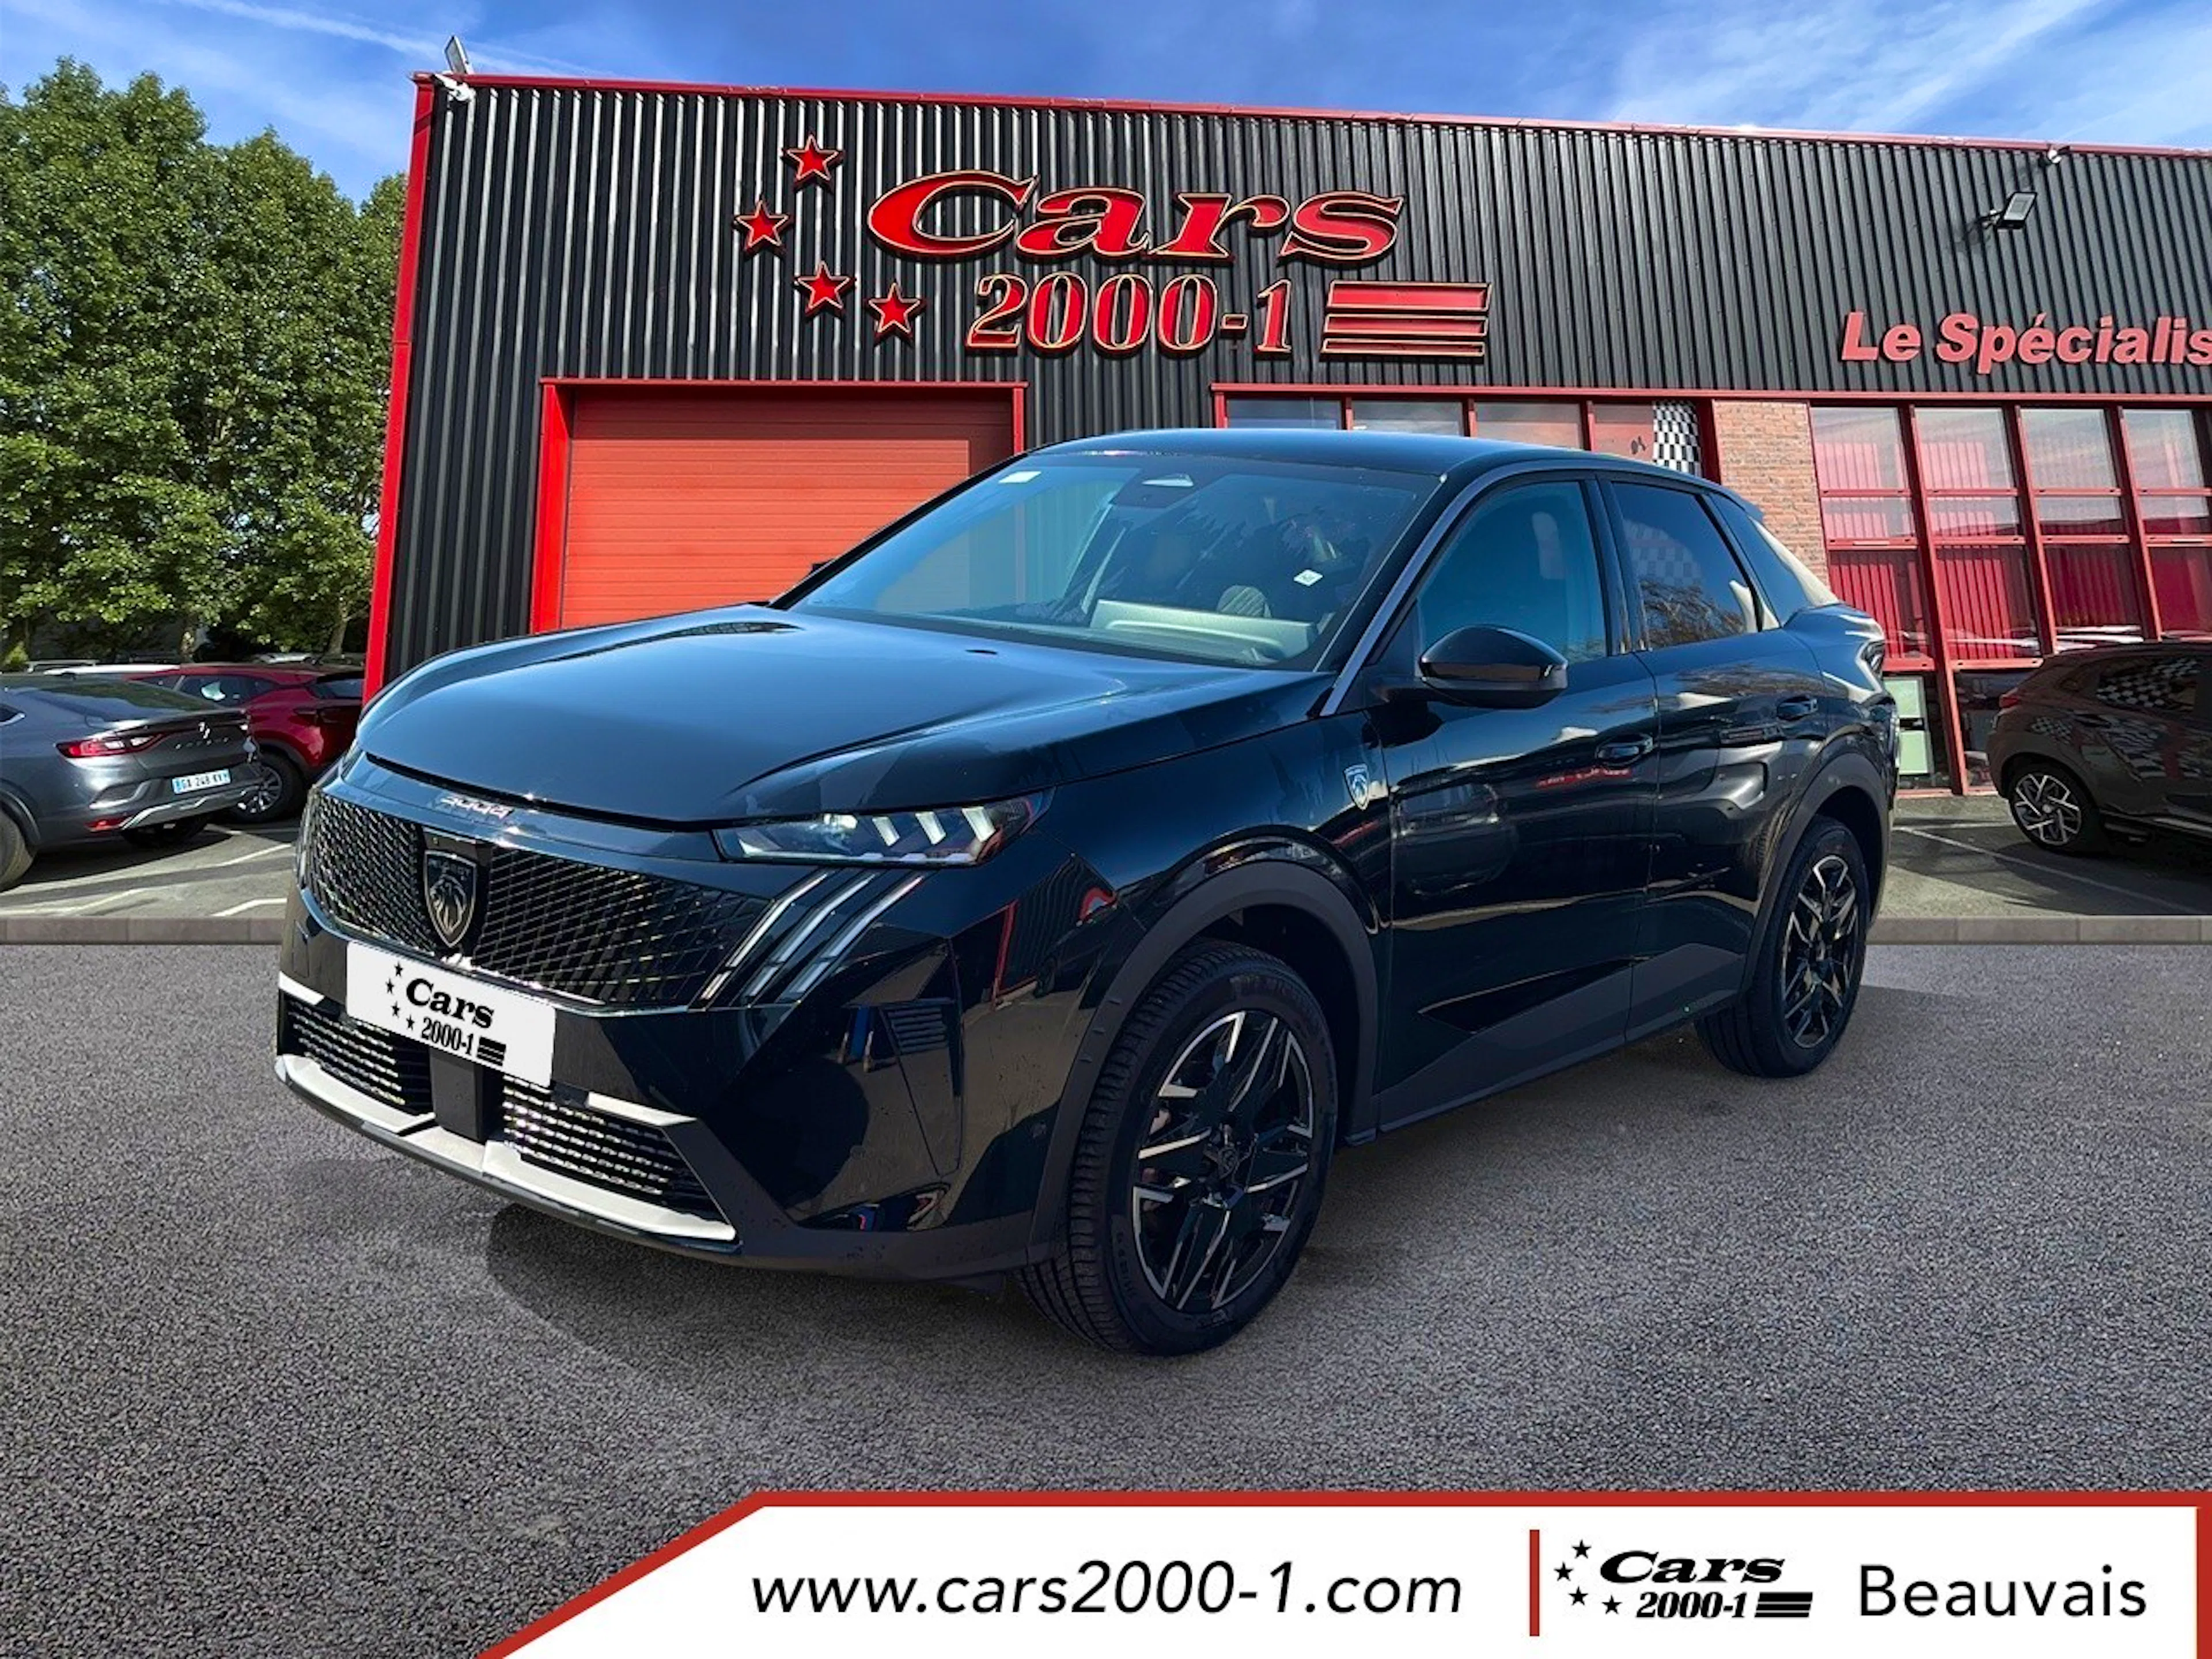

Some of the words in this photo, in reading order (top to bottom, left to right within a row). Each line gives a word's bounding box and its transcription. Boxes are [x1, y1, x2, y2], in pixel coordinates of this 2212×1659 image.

[867, 169, 1405, 263] Cars
[965, 270, 1292, 357] 2000-1
[1841, 310, 1922, 362] Le
[1936, 311, 2212, 375] Spécialis
[406, 978, 494, 1028] Cars
[421, 1017, 474, 1055] 2000-1
